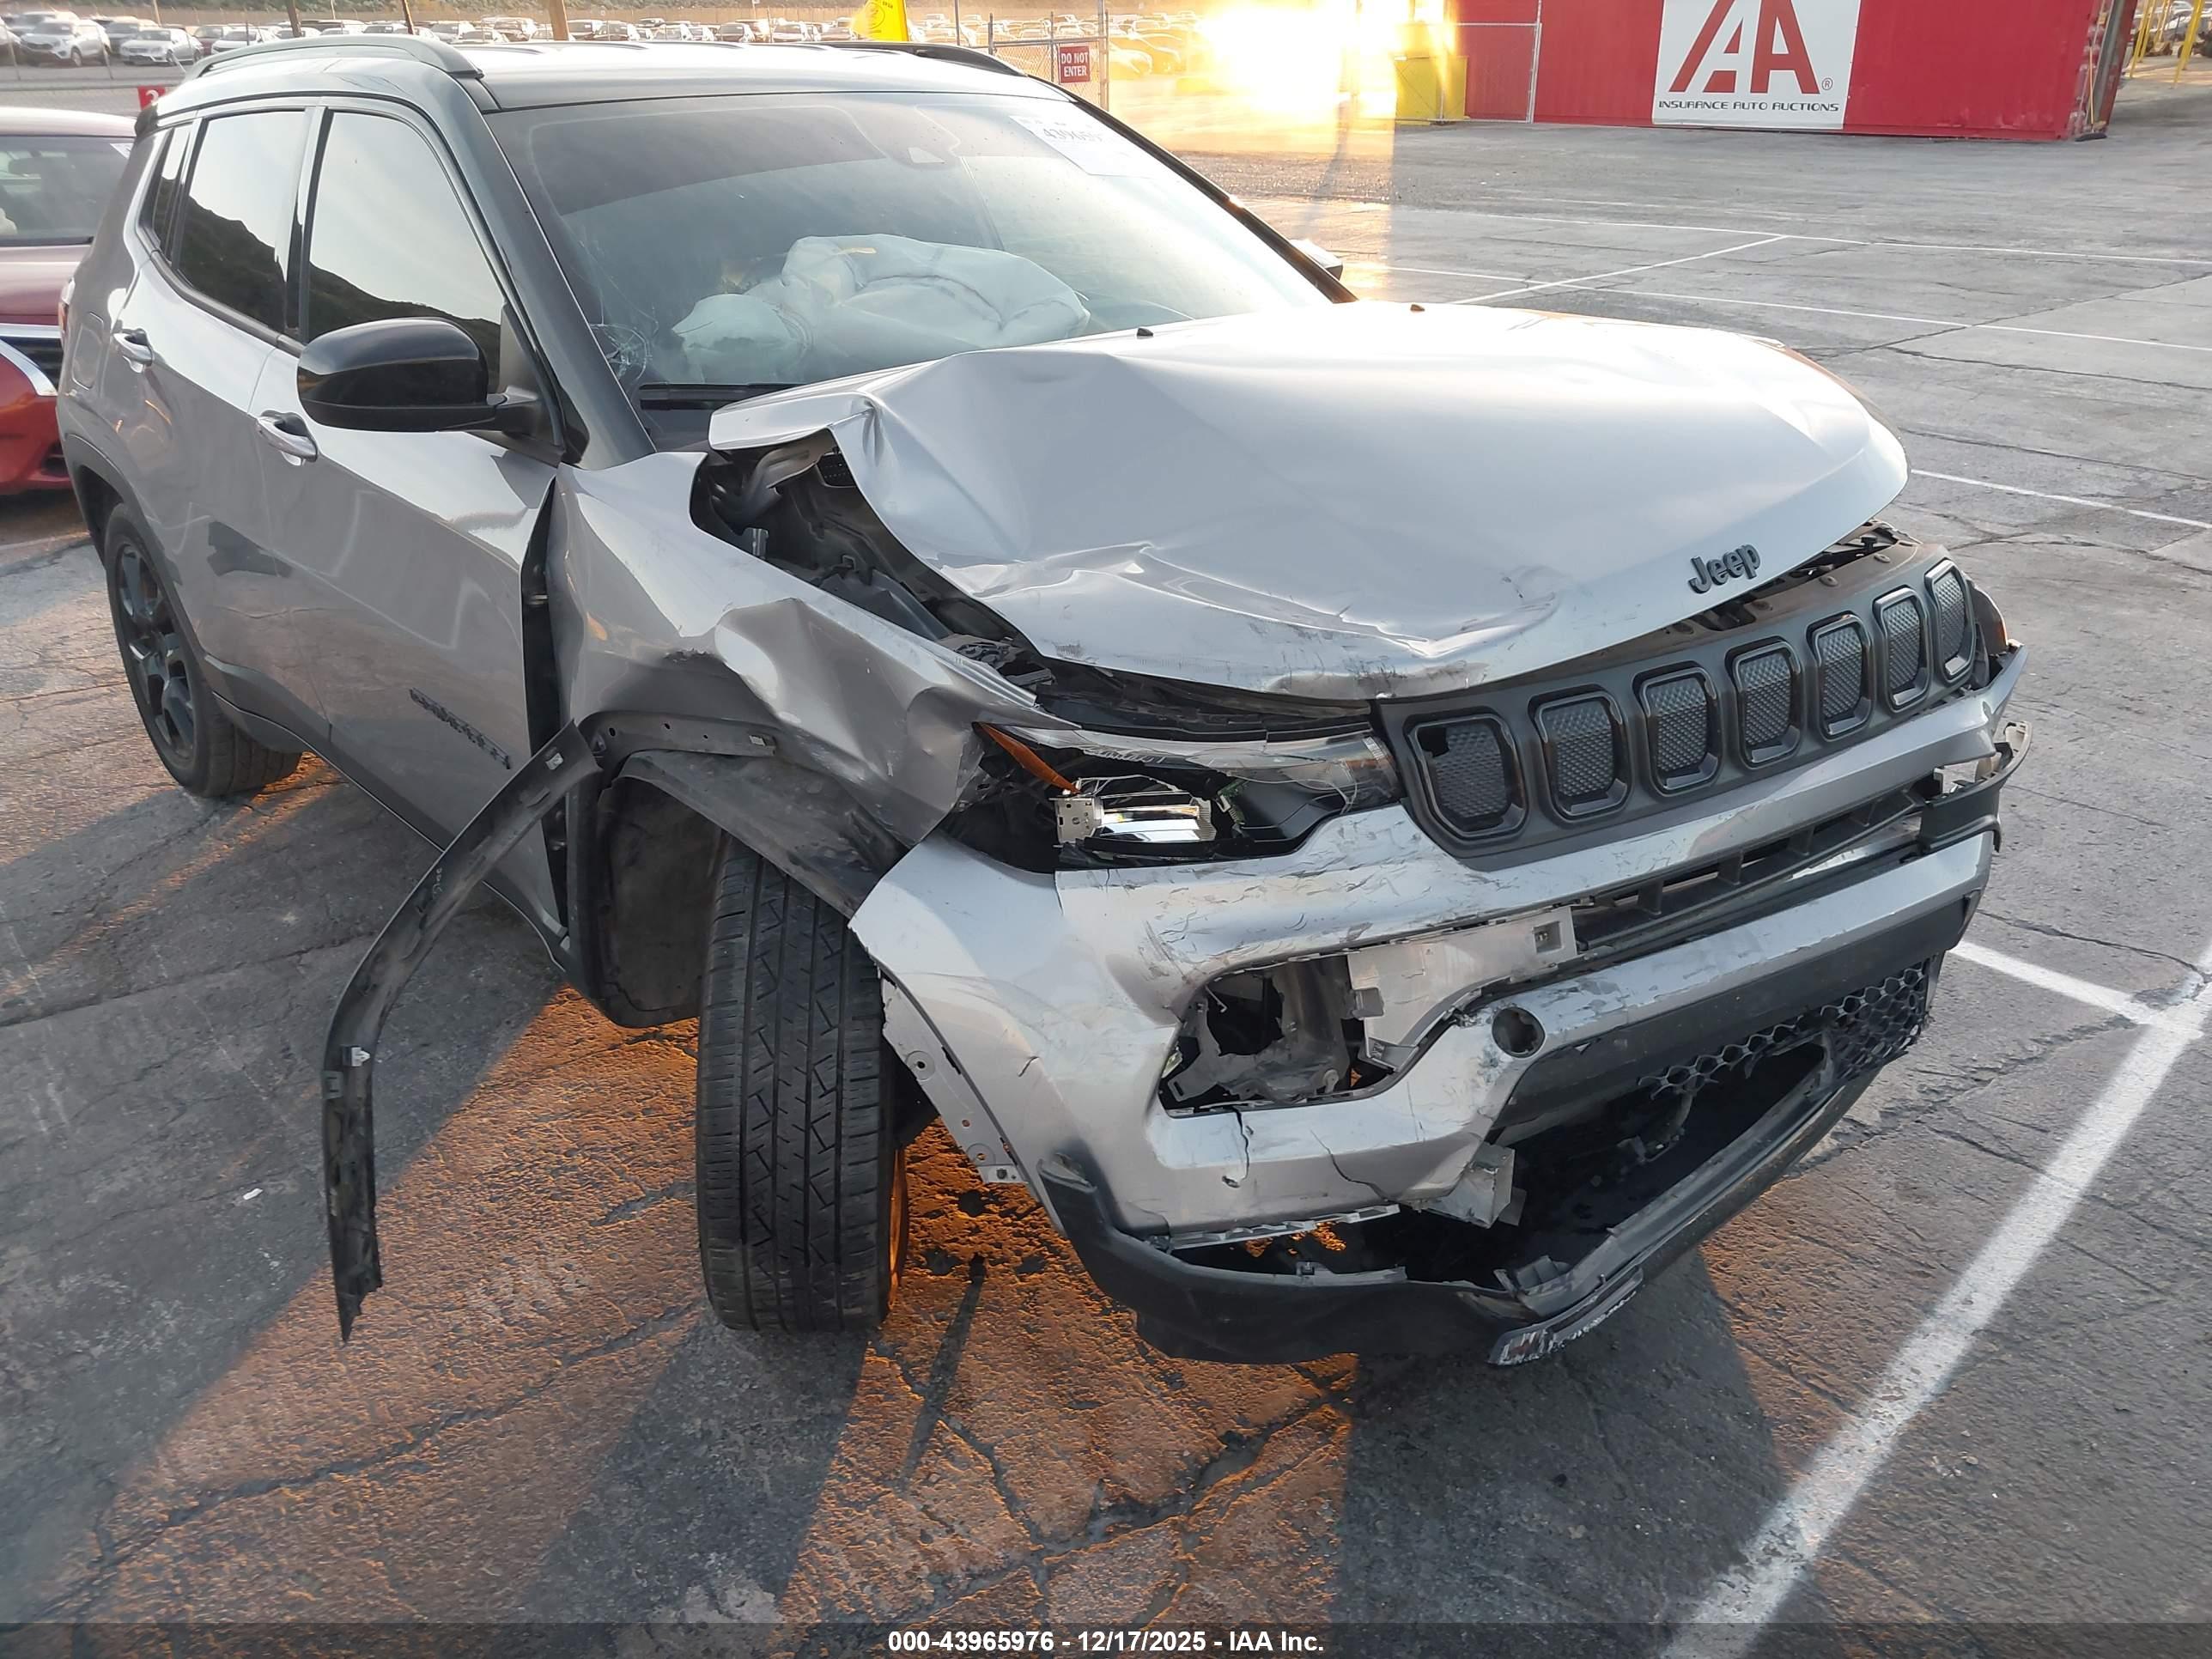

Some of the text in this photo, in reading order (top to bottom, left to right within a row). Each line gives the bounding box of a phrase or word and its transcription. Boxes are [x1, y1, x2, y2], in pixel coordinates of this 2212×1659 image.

[1060, 52, 1089, 64] DO NOT
[1064, 65, 1087, 77] ENTER
[1658, 100, 1839, 112] INSURANCE AUTO AUCTIONS
[1687, 544, 1761, 594] Jeep
